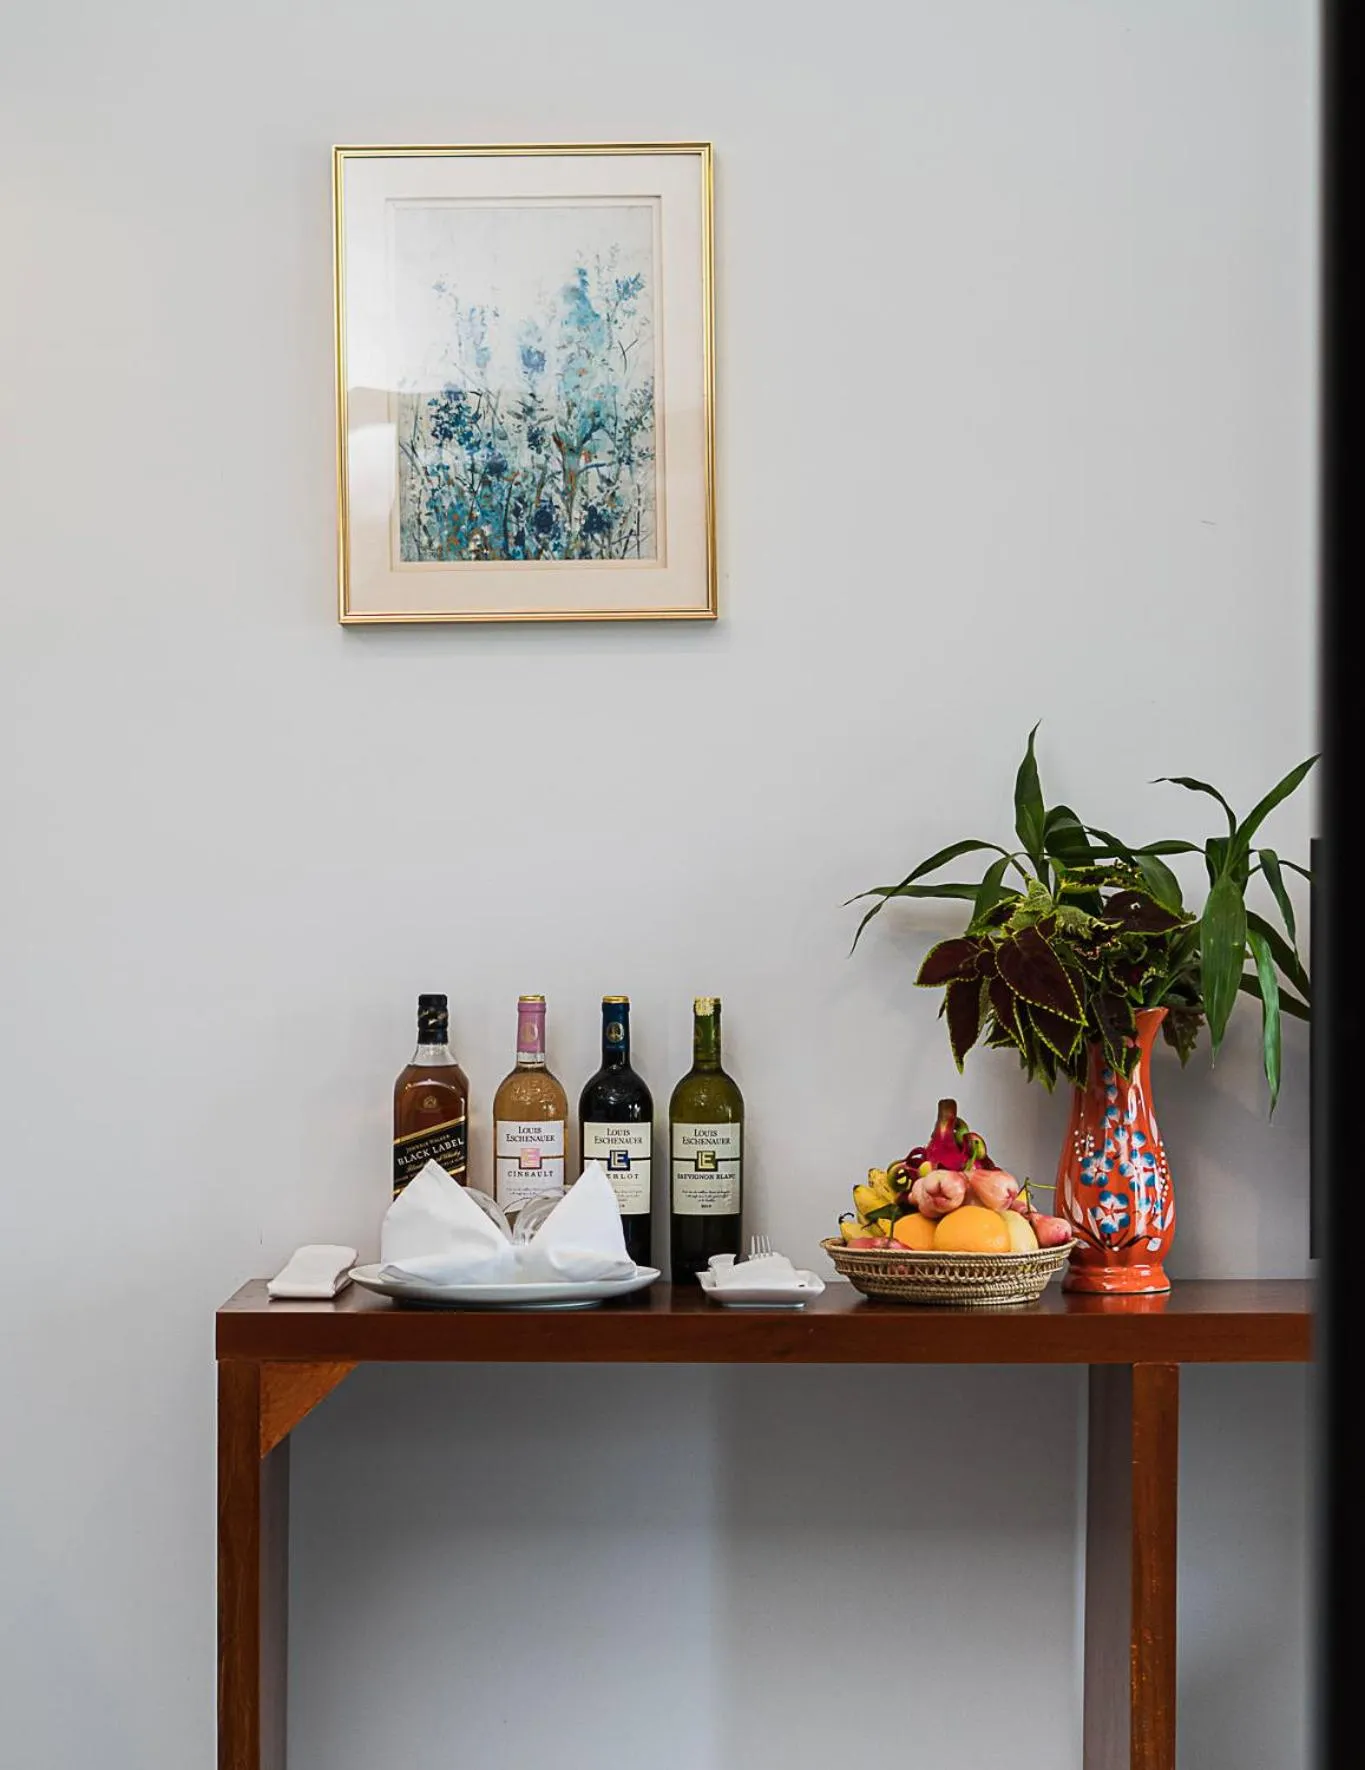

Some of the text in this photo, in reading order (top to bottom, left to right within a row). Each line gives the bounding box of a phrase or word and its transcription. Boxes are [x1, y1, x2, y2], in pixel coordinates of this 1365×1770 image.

[607, 1128, 630, 1136] LOUIS
[695, 1129, 718, 1137] LOUIS
[506, 1134, 555, 1142] ESCHENAUER
[682, 1137, 731, 1145] ESCHENAUER
[397, 1148, 430, 1166] BLACK
[432, 1138, 464, 1153] LABEL
[611, 1151, 628, 1168] E
[698, 1151, 715, 1169] E
